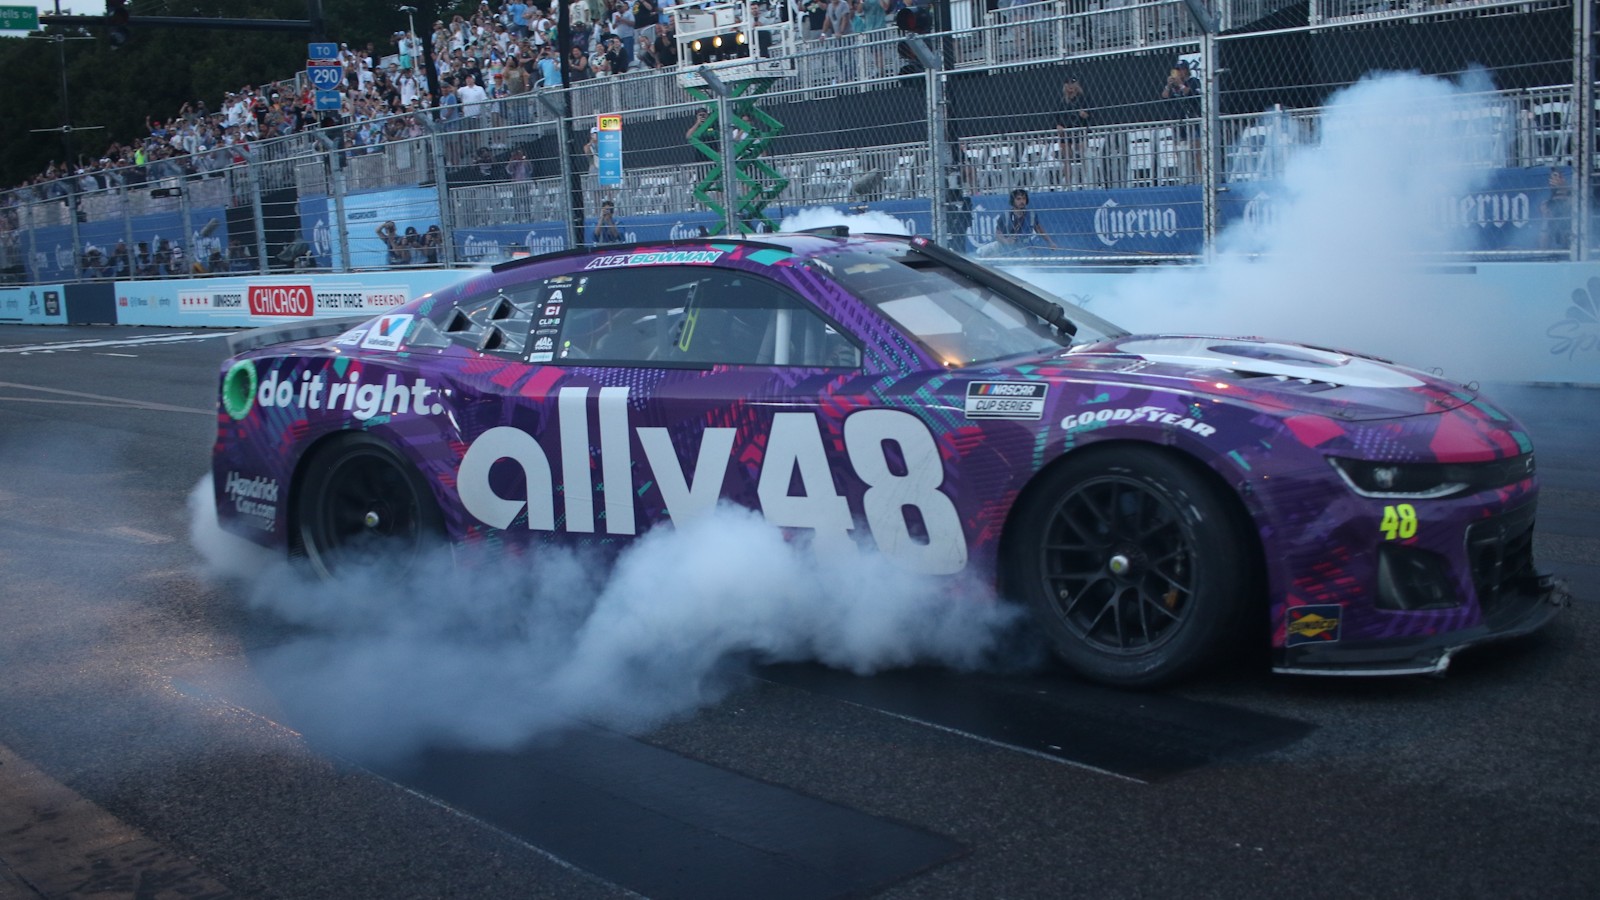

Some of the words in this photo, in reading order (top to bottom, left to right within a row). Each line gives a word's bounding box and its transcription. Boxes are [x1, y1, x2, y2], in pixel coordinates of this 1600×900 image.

[0, 9, 19, 19] ells
[22, 11, 32, 19] Dr
[316, 46, 331, 56] TO
[313, 69, 339, 84] 290
[602, 119, 619, 128] 900
[1094, 198, 1177, 246] Cuervo
[216, 294, 242, 308] NASCAR
[253, 288, 308, 314] CHICAGO
[317, 293, 342, 308] STREET
[343, 294, 364, 308] RACE
[366, 294, 405, 306] WEEKEND
[258, 369, 294, 408] do
[298, 369, 324, 410] it
[327, 370, 444, 421] right.
[990, 384, 1037, 396] NASCAR
[975, 400, 997, 411] CUP
[997, 401, 1034, 412] SERIES
[1060, 405, 1217, 438] GOODYEAR
[224, 470, 280, 503] Hendrick
[757, 408, 969, 576] 48
[1380, 503, 1418, 540] 48
